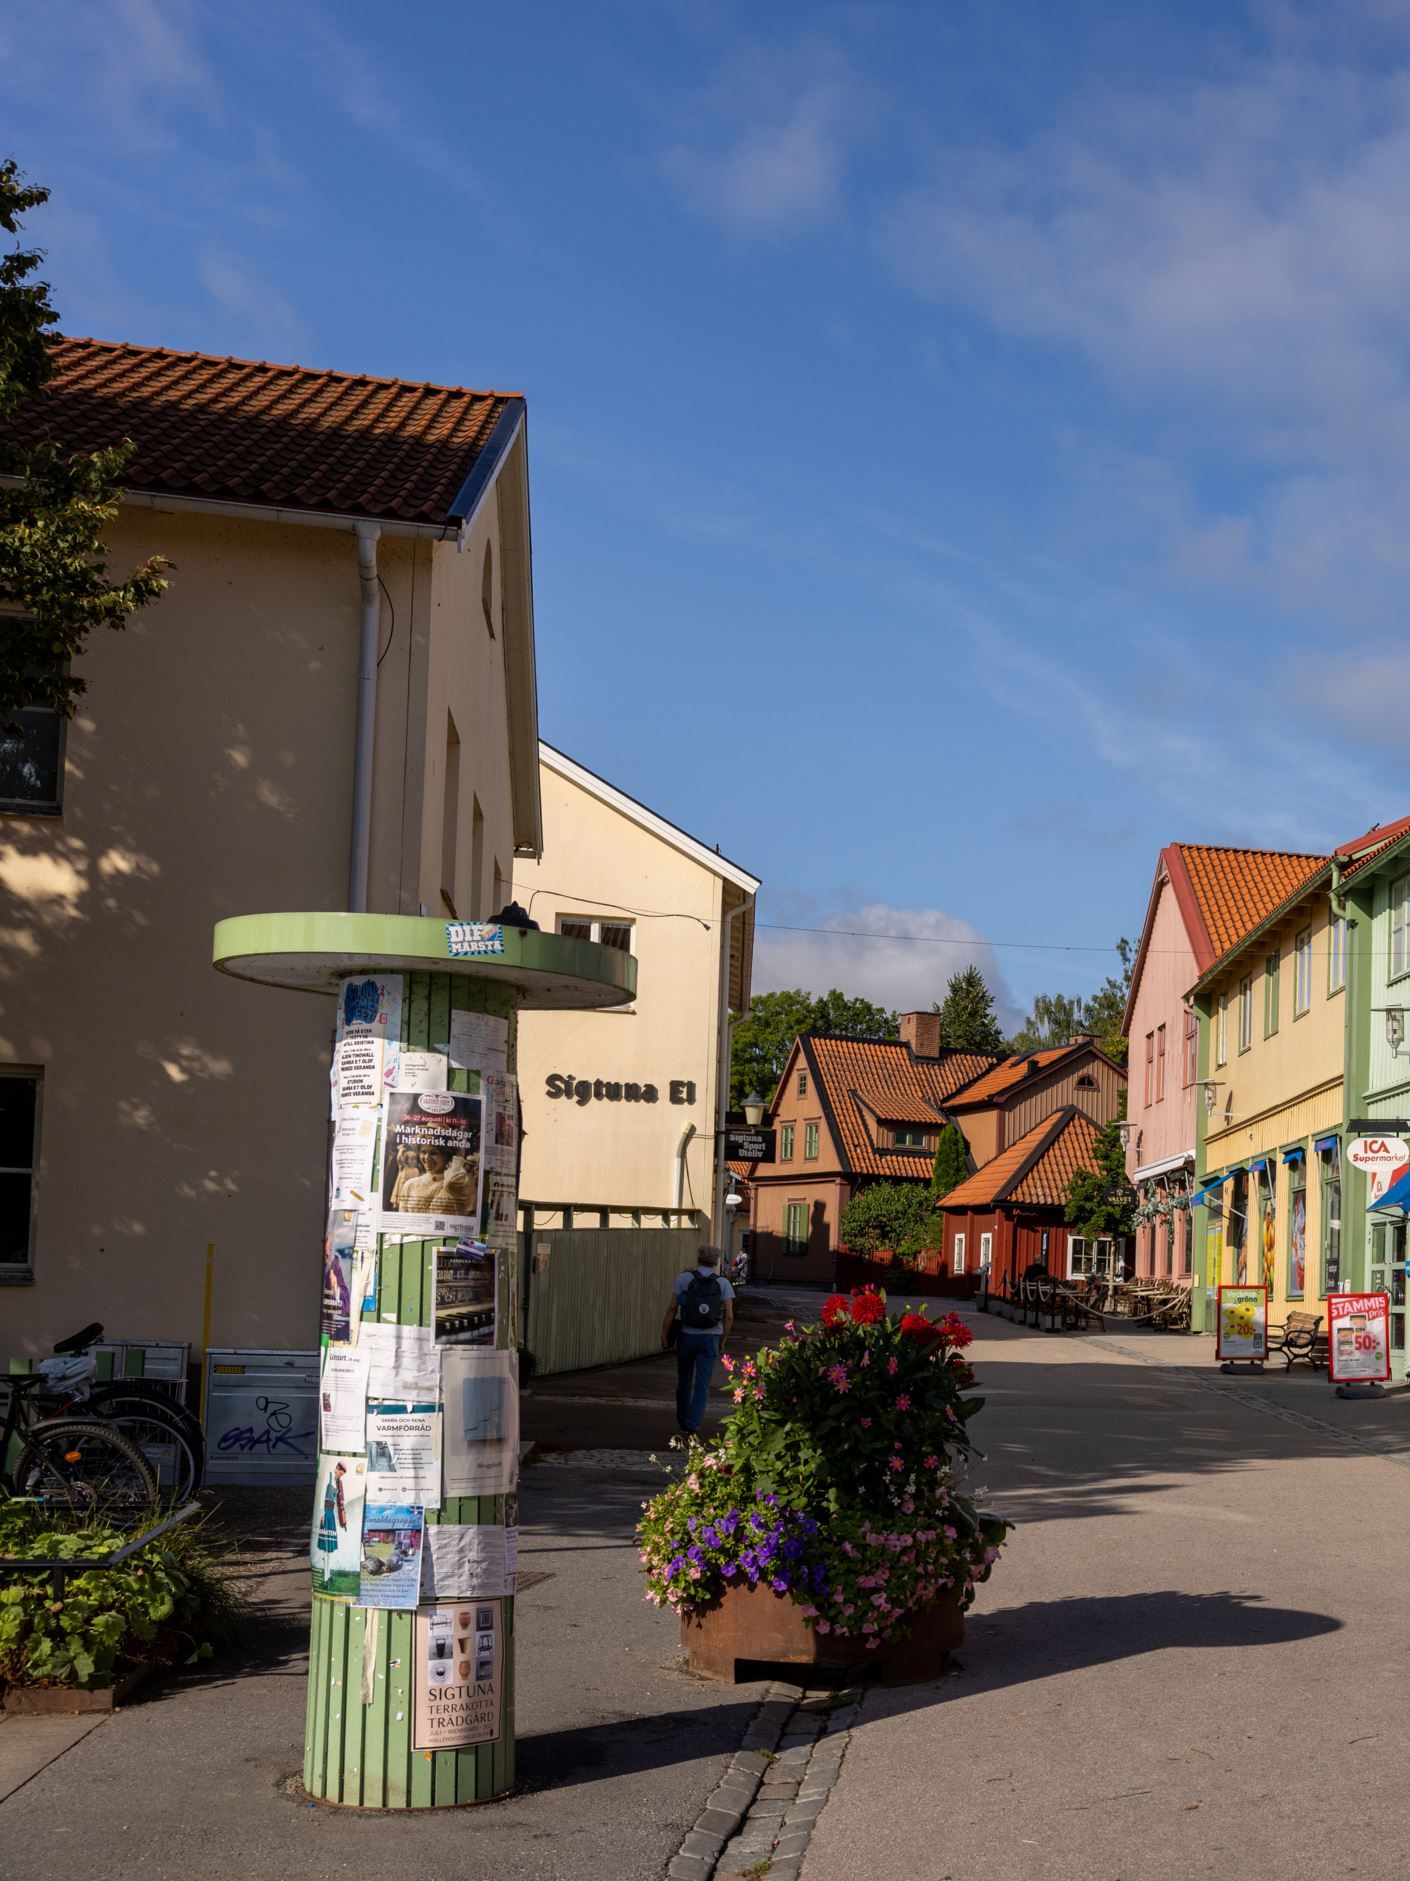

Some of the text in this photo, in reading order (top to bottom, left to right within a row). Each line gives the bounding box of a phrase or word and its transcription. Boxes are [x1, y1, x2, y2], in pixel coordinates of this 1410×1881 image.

[448, 925, 483, 942] DIF
[545, 1073, 697, 1107] Sigtuna El
[395, 1124, 473, 1140] Marknadsdagar
[729, 1134, 763, 1143] Sigtuna
[402, 1136, 446, 1146] historisk
[447, 1140, 471, 1149] anda
[743, 1141, 766, 1151] Sport
[1363, 1139, 1391, 1154] ICA
[1353, 1153, 1406, 1164] Supermarket
[1237, 1296, 1258, 1304] gröna
[1331, 1297, 1385, 1317] STAMMIS
[1354, 1334, 1380, 1350] 50:-
[376, 1423, 432, 1431] VARMFÖRRÅD
[428, 1682, 494, 1702] SIGTUNA
[427, 1698, 494, 1715] TERRAKOTTA
[427, 1711, 494, 1729] TRÄDGÅRD
